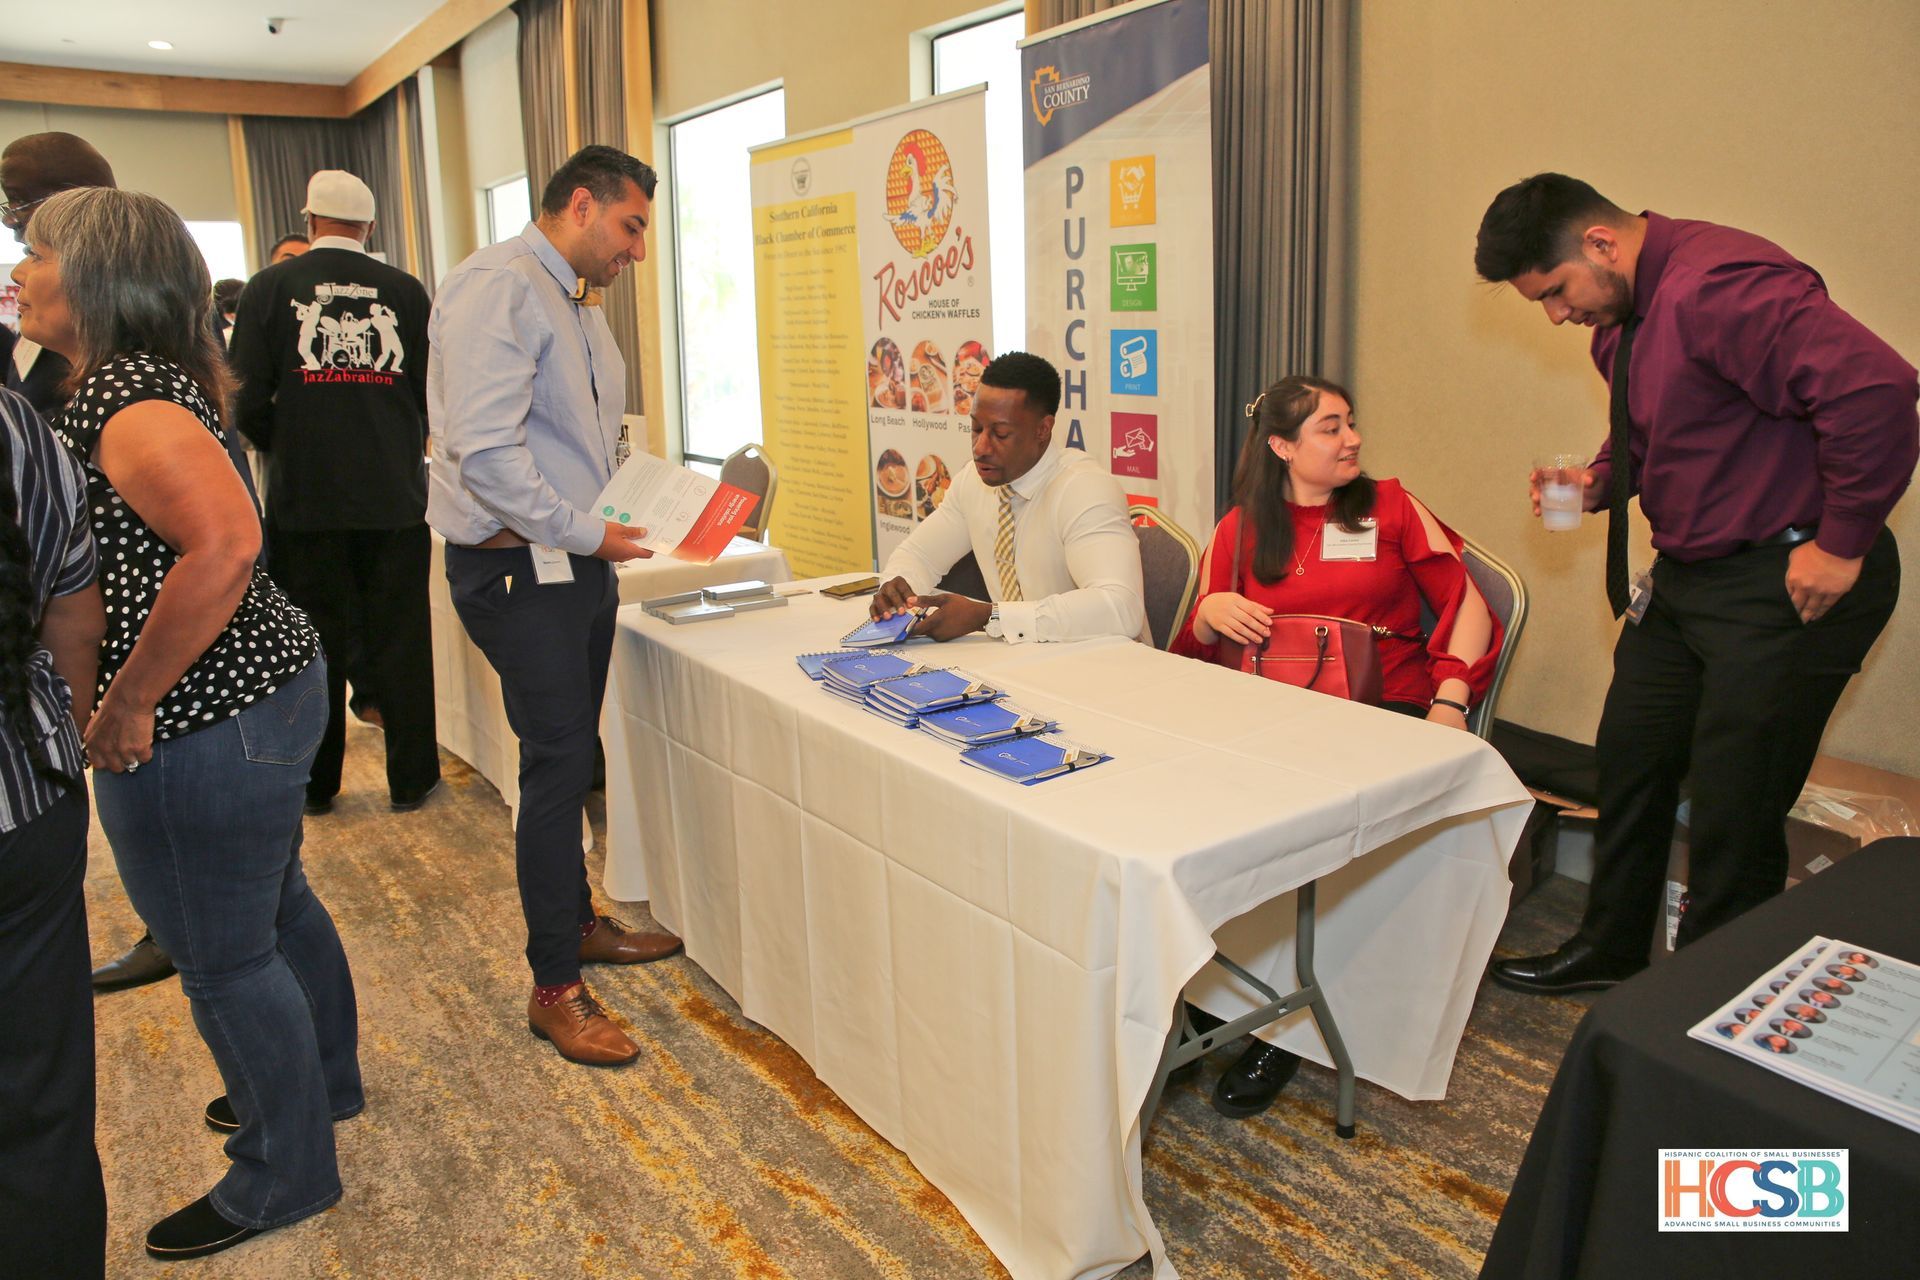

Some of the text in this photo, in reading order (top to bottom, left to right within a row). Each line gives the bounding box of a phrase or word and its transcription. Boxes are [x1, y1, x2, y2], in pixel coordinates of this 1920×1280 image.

[1044, 75, 1090, 95] SAN BERNARDINO
[1043, 84, 1090, 109] COUNTY
[801, 202, 838, 218] California
[775, 229, 806, 244] Chamber
[807, 227, 815, 240] of
[816, 224, 856, 238] Commerce
[873, 226, 975, 331] Roscoe's
[929, 298, 961, 309] HOUSE OF
[1064, 166, 1087, 451] PURCHA
[947, 308, 981, 319] WAFFLES
[1125, 383, 1142, 392] PRINT
[871, 415, 906, 427] Long Beach
[912, 417, 948, 431] Hollywood
[958, 422, 972, 433] Pas
[1126, 465, 1141, 474] MAIL
